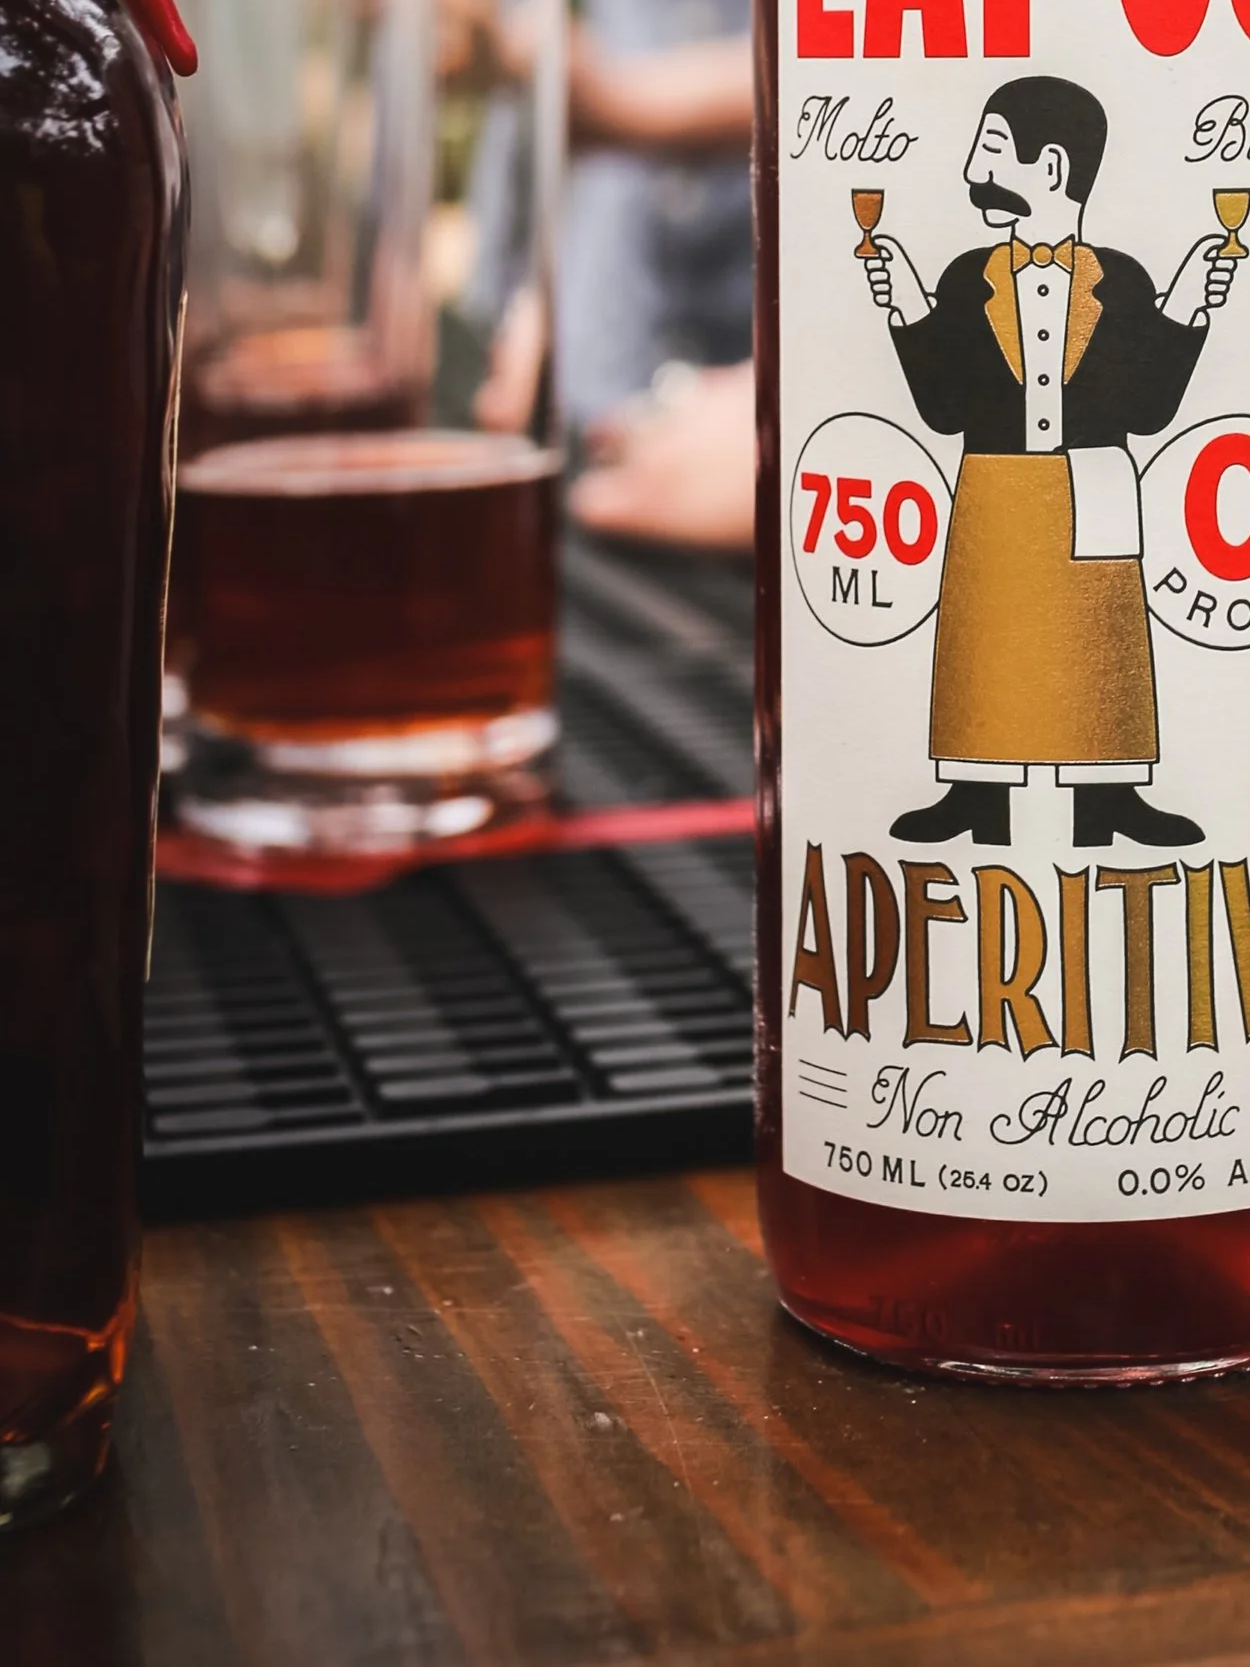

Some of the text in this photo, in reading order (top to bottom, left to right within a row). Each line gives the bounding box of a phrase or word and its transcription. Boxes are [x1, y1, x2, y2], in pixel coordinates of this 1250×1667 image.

[790, 95, 918, 162] Molto
[800, 472, 938, 566] 750
[831, 566, 893, 608] ML
[867, 1065, 1240, 1146] Non Alcoholic
[824, 1140, 872, 1178] 750
[882, 1155, 926, 1188] ML
[938, 1164, 992, 1191] (25.4
[1003, 1170, 1048, 1197] OZ)
[1118, 1163, 1205, 1196] 0.0%
